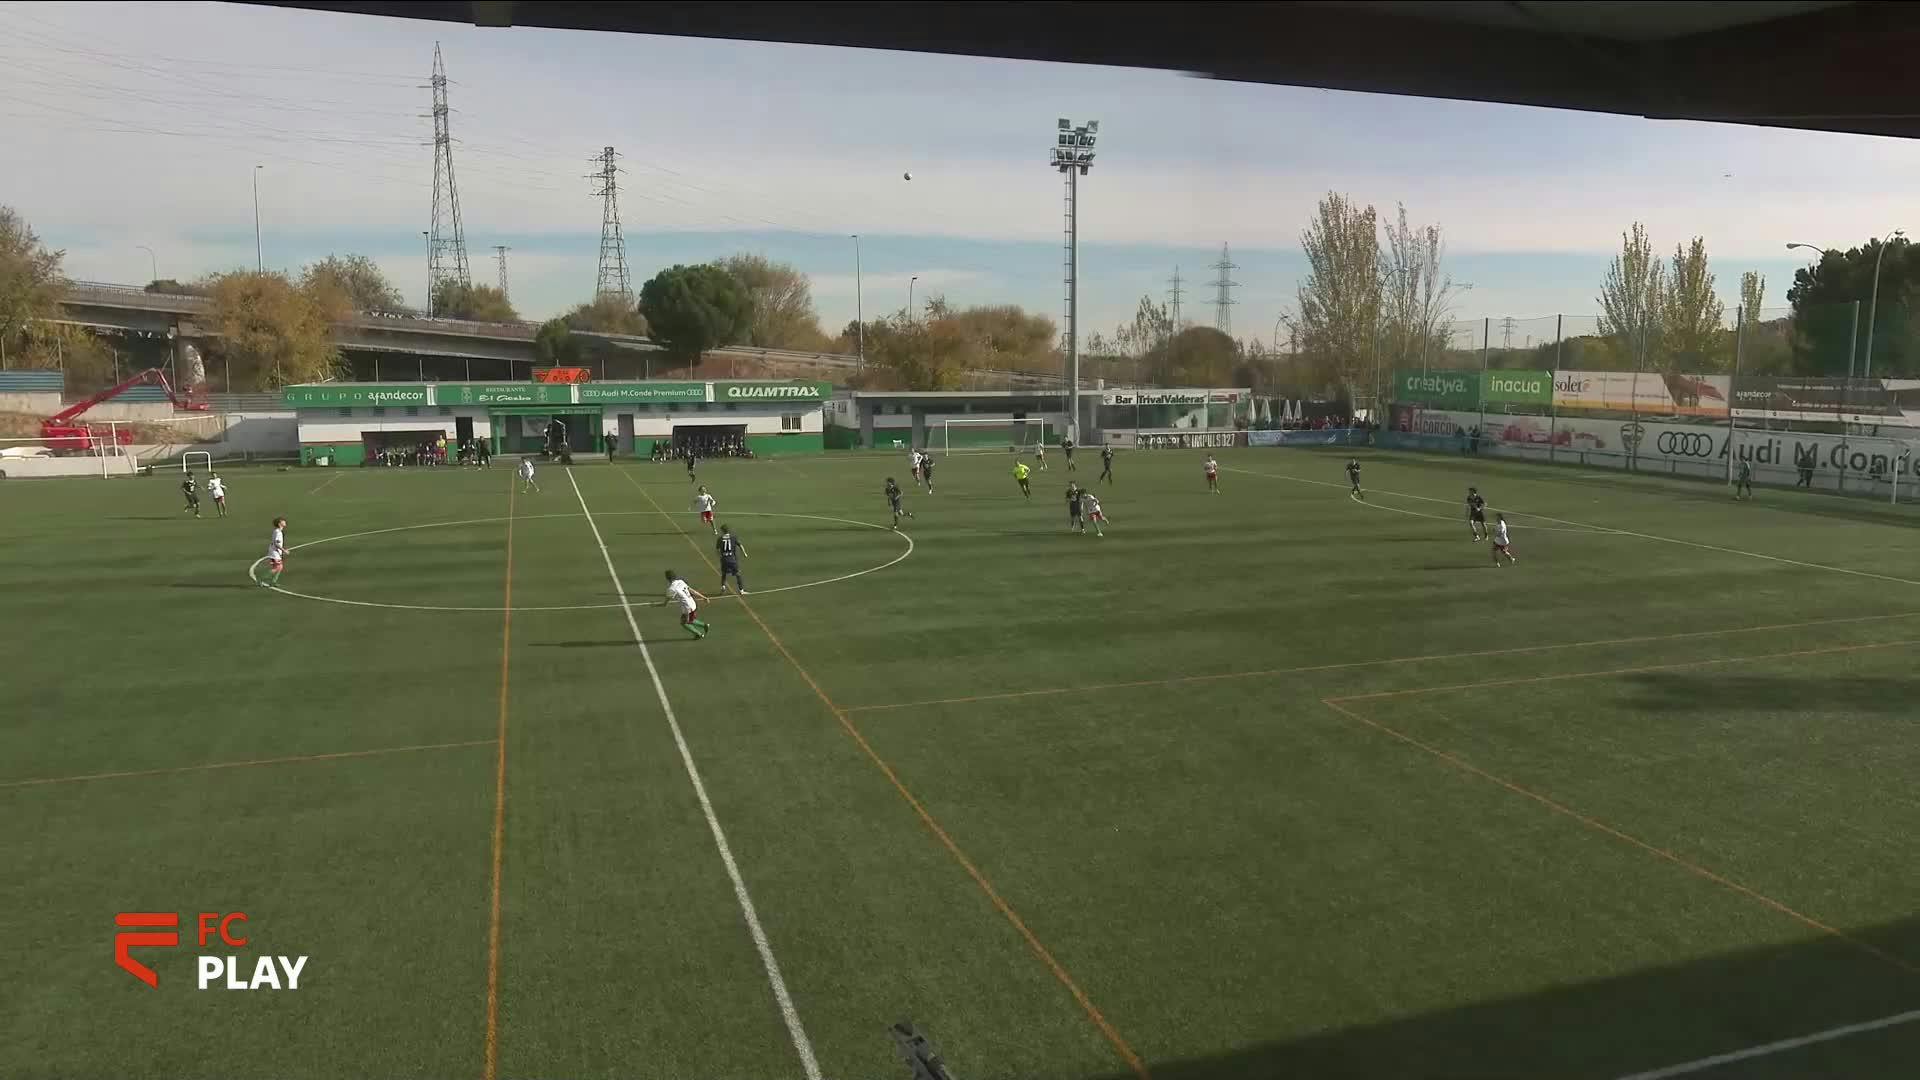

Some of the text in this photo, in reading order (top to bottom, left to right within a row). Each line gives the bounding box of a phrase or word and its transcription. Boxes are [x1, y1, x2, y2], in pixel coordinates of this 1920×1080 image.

[1491, 376, 1541, 393] inacua
[287, 390, 424, 406] GRUPO afandecor
[601, 388, 686, 398] Audi M.Conde Premium
[727, 386, 820, 398] QUAMTRAX
[1115, 395, 1133, 405] Bar
[1718, 436, 1782, 465] Audi
[722, 539, 732, 551] 71
